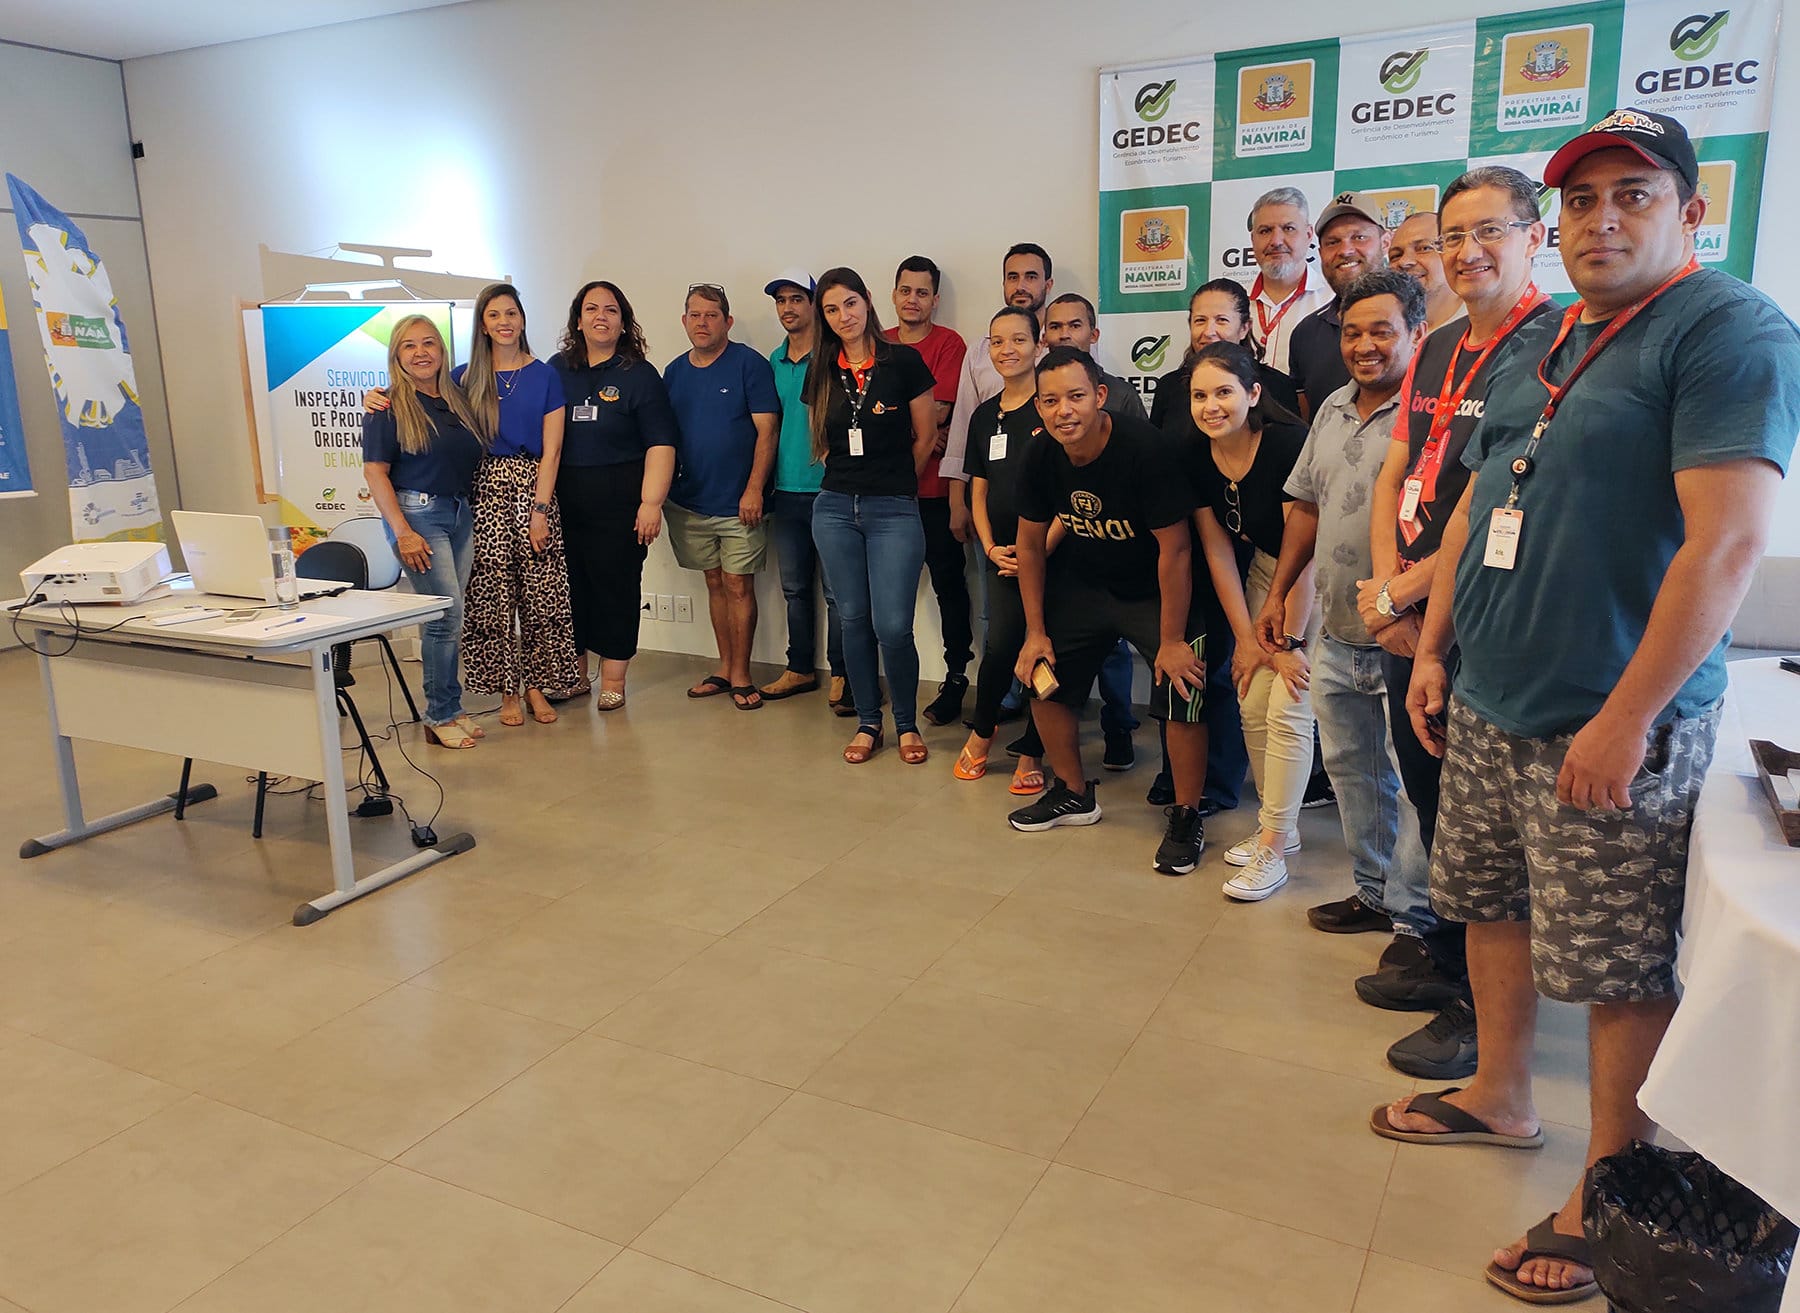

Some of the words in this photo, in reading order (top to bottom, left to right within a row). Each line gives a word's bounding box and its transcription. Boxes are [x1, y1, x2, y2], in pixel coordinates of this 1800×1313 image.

[1635, 60, 1759, 95] GEDEC
[1505, 96, 1556, 105] PREFEITURA
[1634, 97, 1670, 106] Gerência
[1684, 88, 1756, 100] Desenvolvimento
[1704, 100, 1738, 109] Turismo
[1351, 93, 1456, 124] GEDEC
[1504, 97, 1581, 119] NAVIRAÍ
[1112, 121, 1200, 149] GEDEC
[1241, 126, 1306, 146] NAVIRAÍ
[1125, 267, 1182, 283] NAVIRAÍ
[378, 371, 388, 387] D
[295, 389, 356, 409] INSPEÇÃO
[311, 412, 326, 427] DE
[331, 410, 363, 427] PROD
[314, 430, 362, 447] ORIGEM
[323, 452, 337, 467] DE
